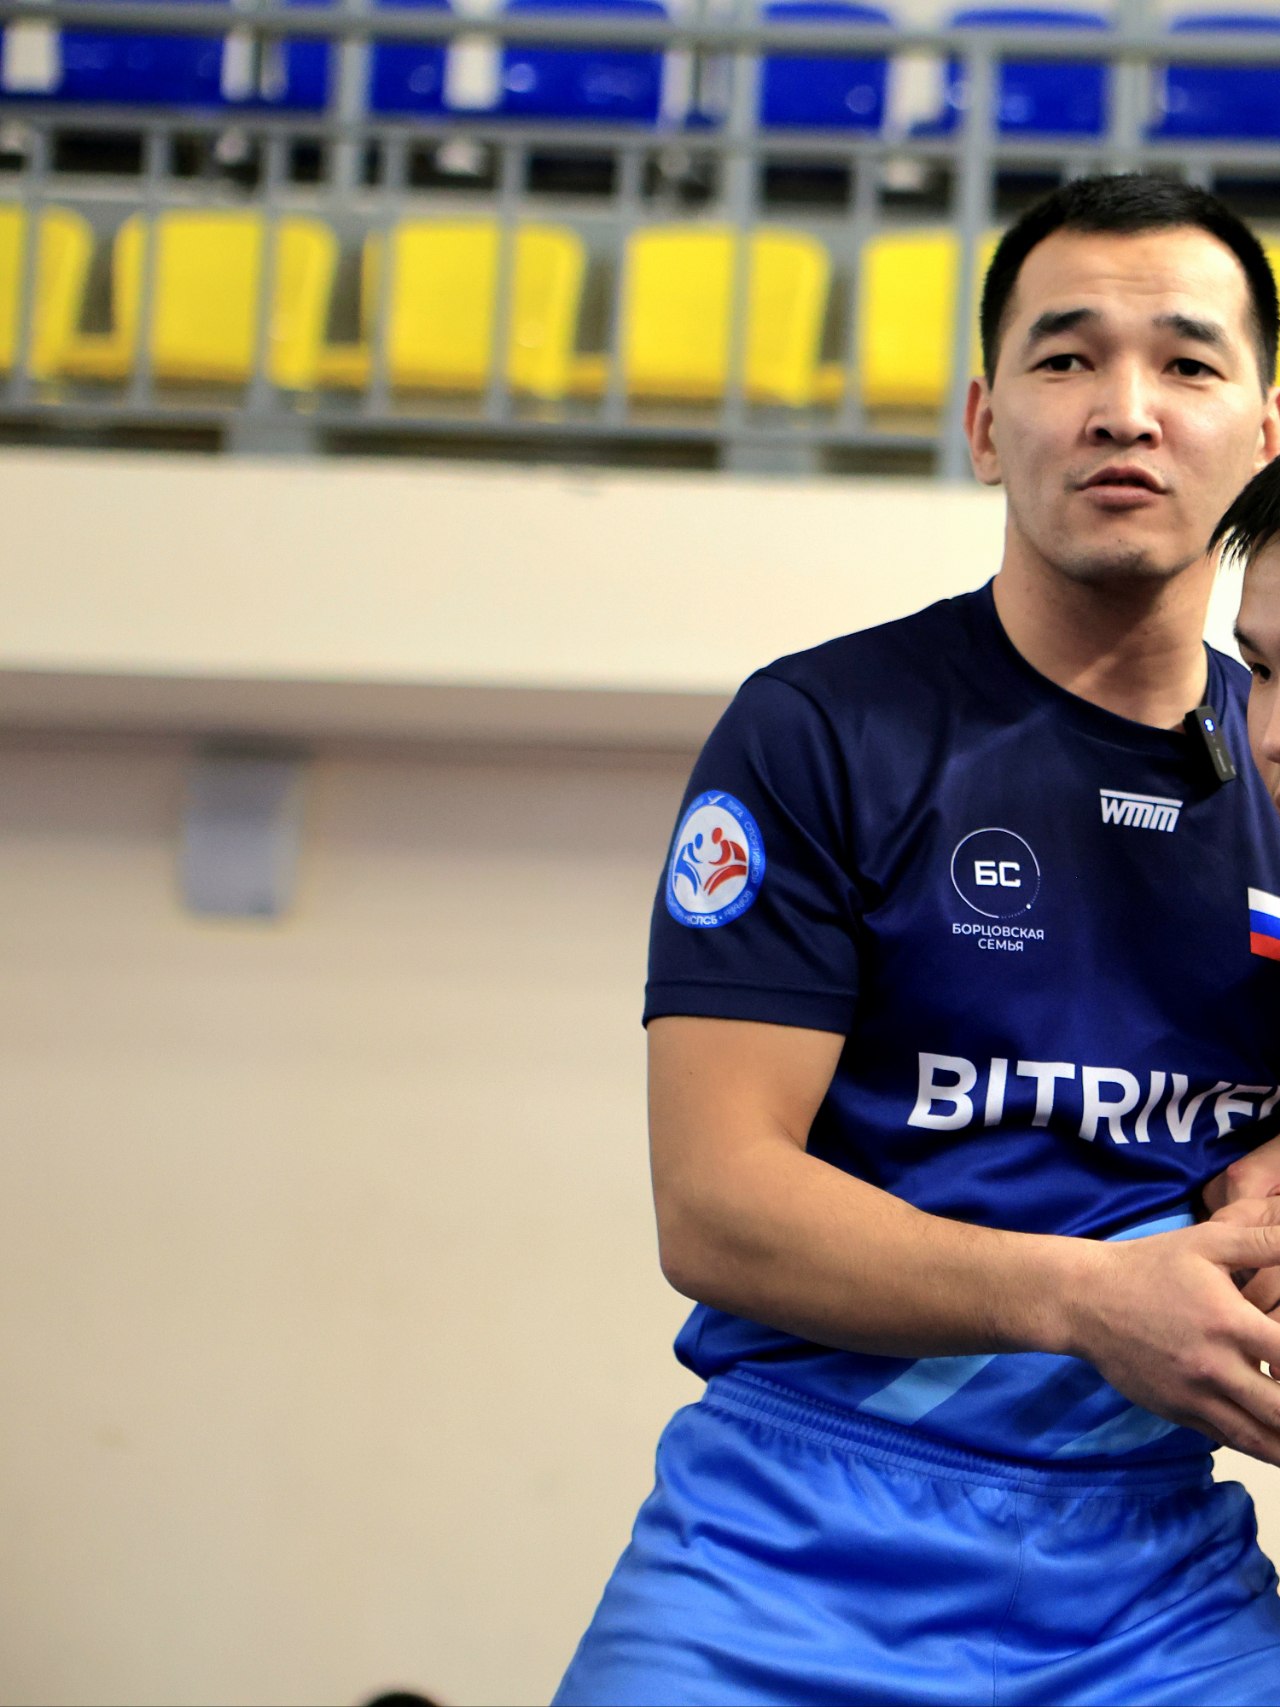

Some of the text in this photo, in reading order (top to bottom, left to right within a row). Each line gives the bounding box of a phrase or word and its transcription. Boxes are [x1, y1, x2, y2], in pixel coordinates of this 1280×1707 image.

[974, 860, 1021, 888] БС
[952, 922, 1045, 941] БОРЦОВСКАЯ
[977, 938, 1024, 952] СЕМЬЯ
